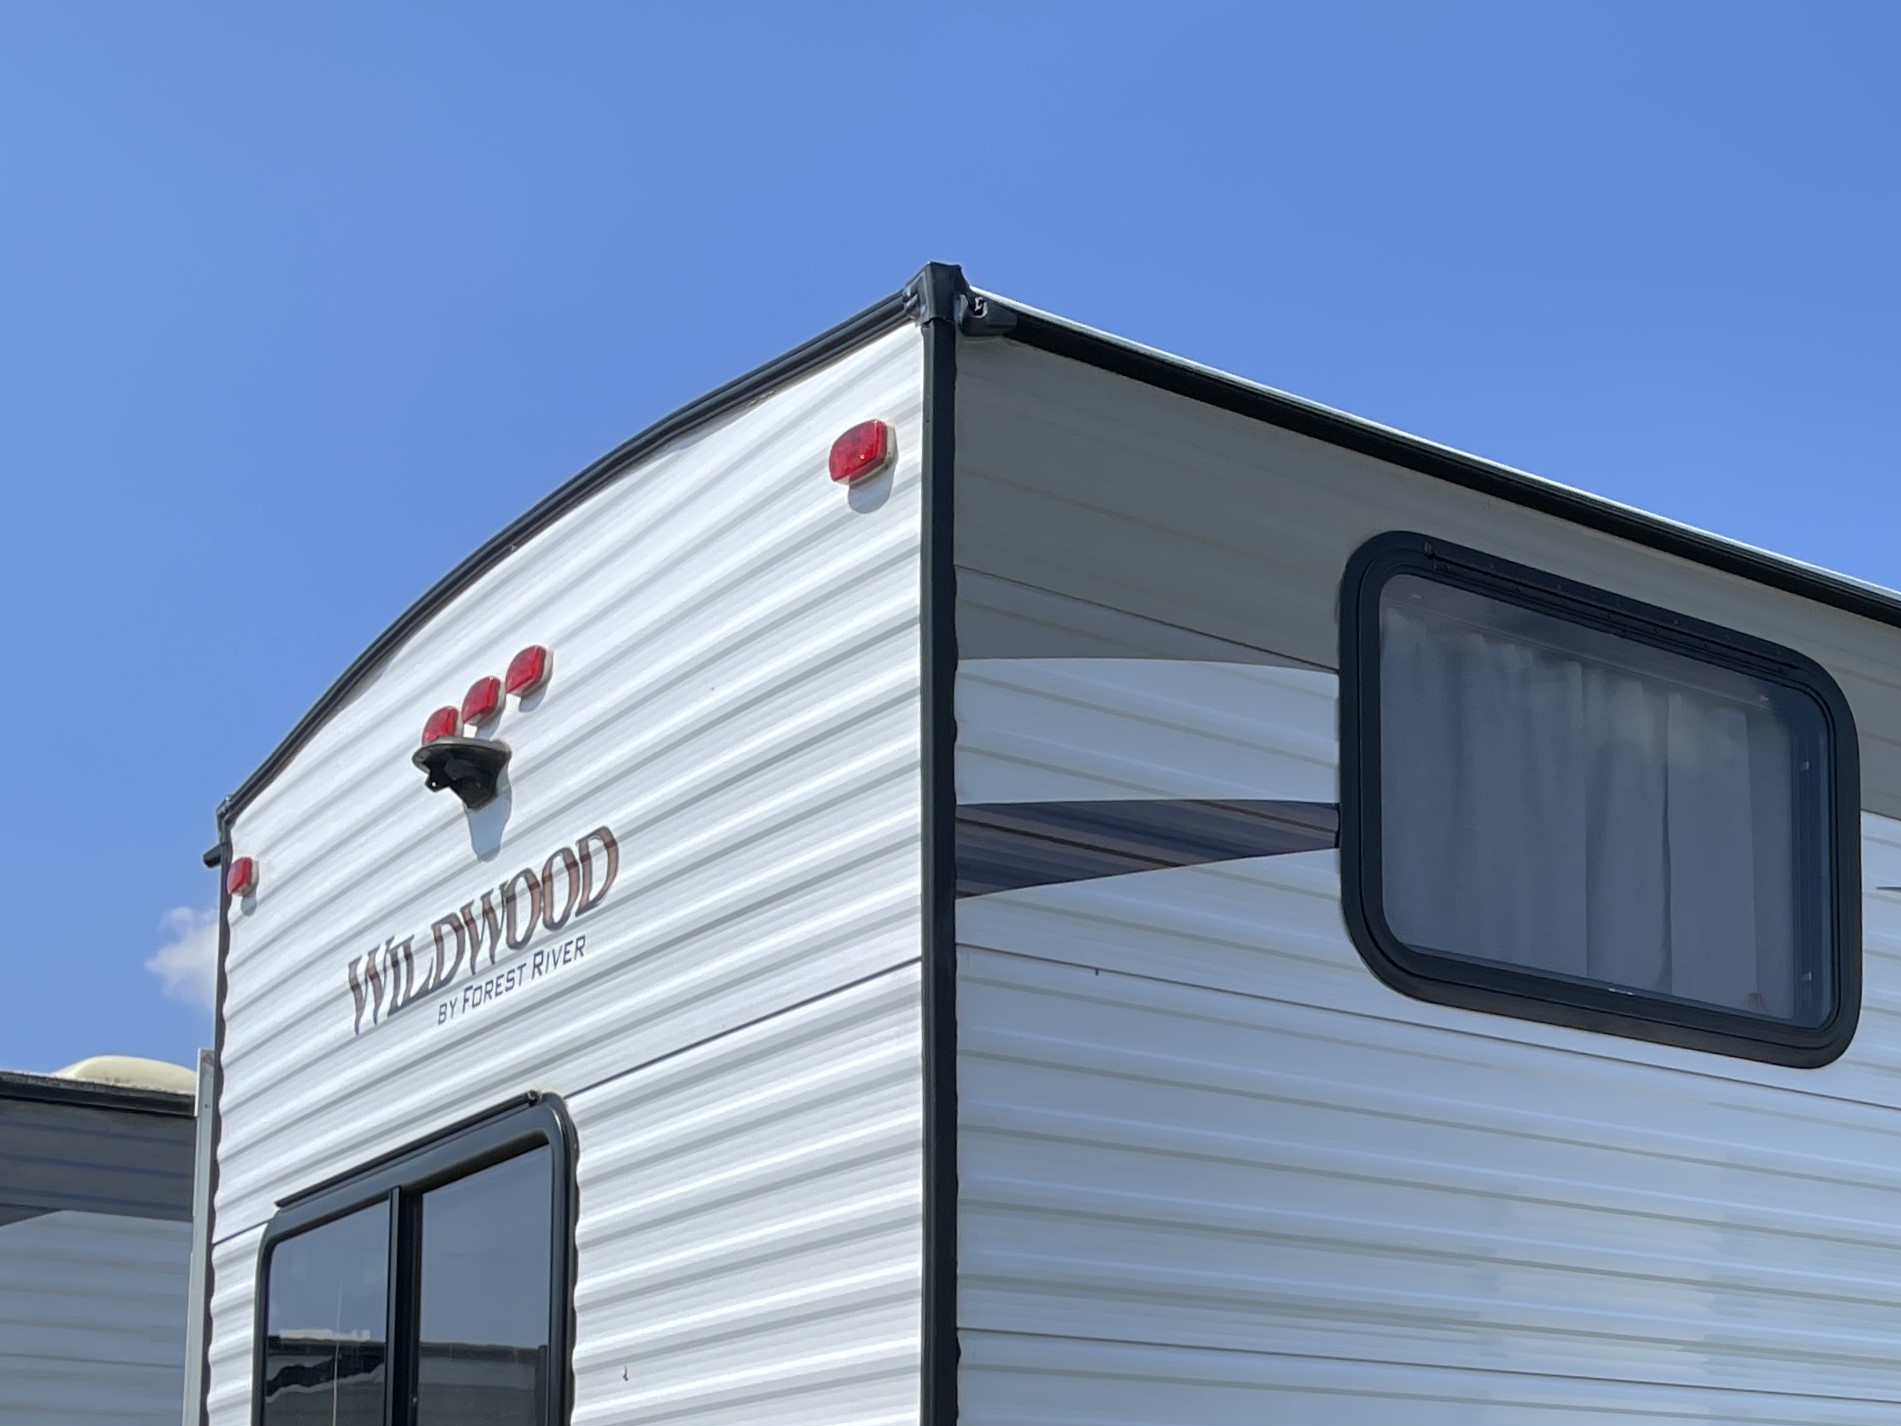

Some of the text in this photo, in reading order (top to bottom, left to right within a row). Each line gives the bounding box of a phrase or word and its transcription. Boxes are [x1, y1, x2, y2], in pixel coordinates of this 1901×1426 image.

[348, 825, 620, 1036] WILDWOOD
[437, 934, 587, 1026] BY FOREST RIVER
